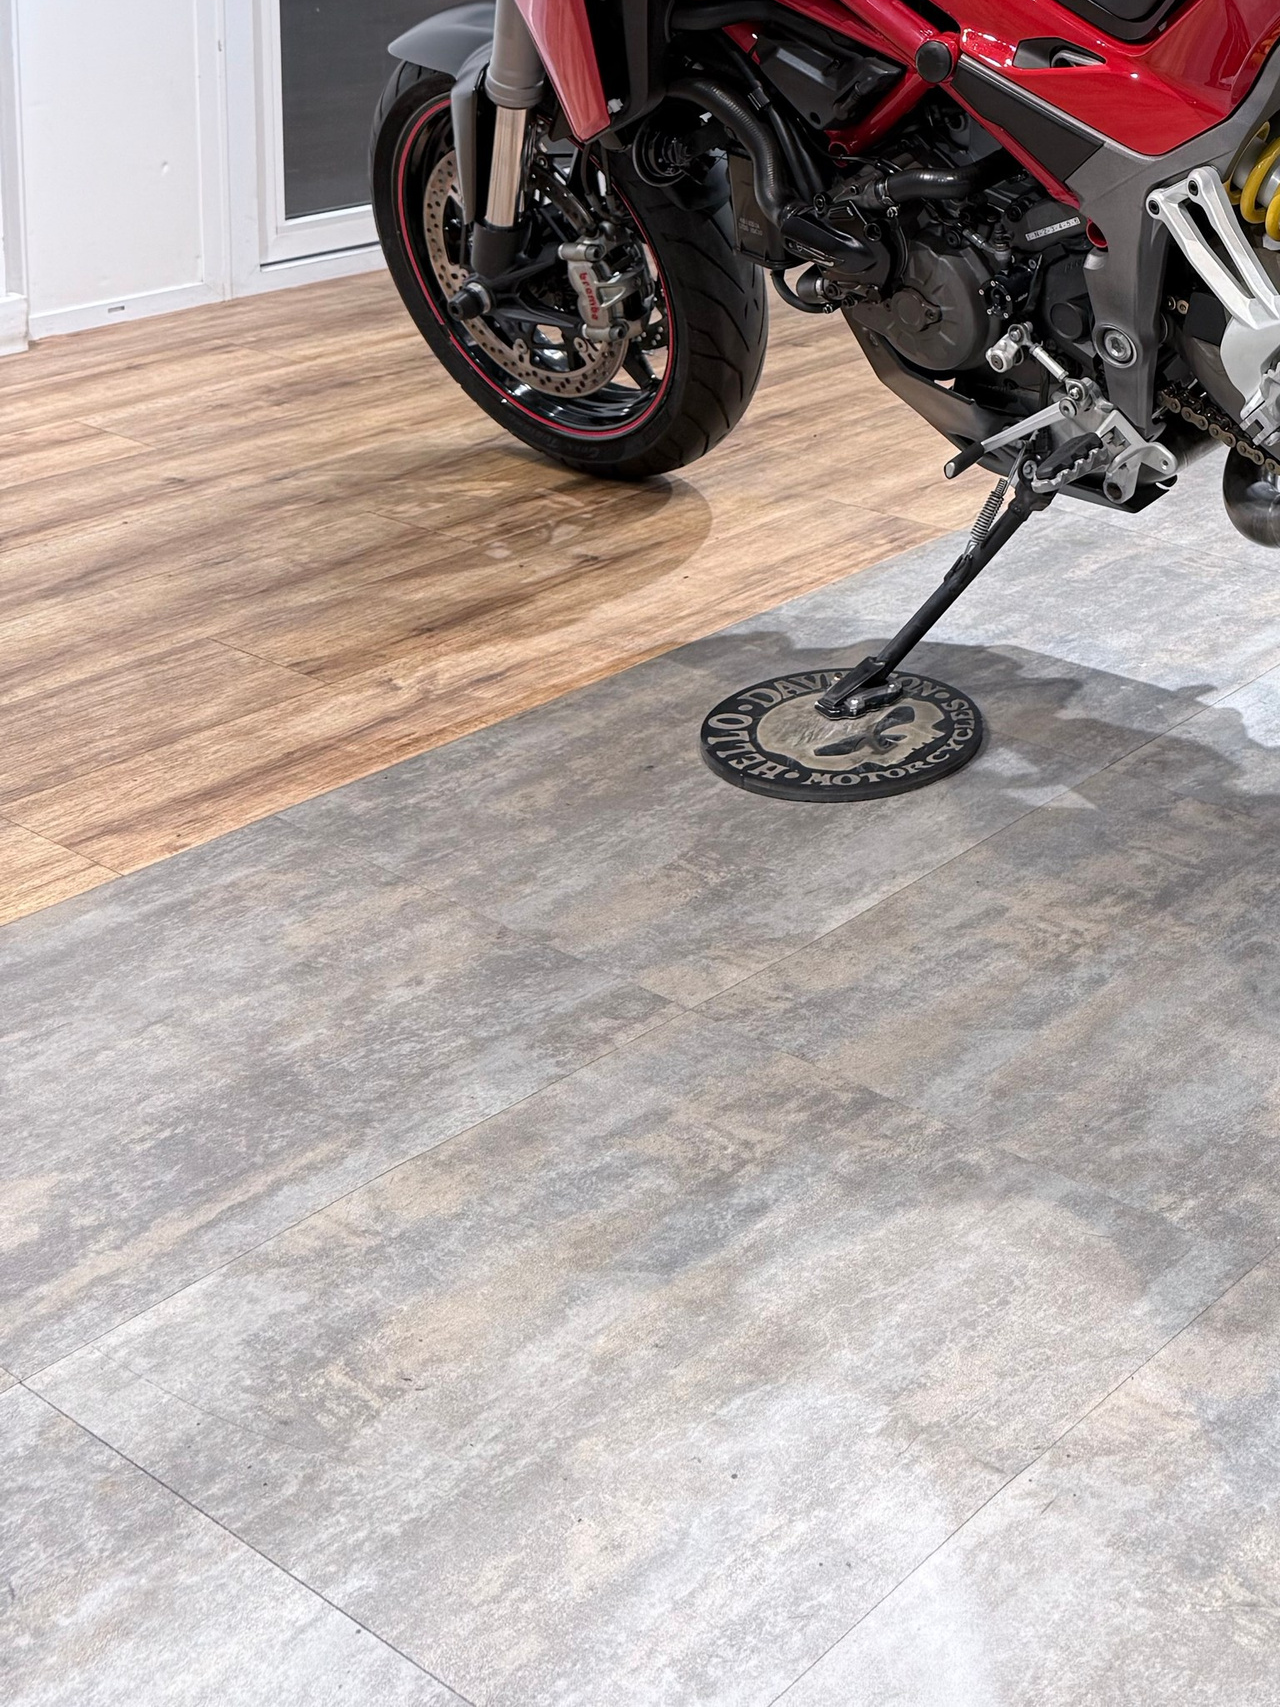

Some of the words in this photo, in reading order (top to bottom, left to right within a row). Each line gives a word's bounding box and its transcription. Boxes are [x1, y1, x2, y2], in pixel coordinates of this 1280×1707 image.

[579, 272, 600, 321] brembo
[707, 712, 790, 780] HELLO
[801, 699, 975, 786] MOTORCYCLES
